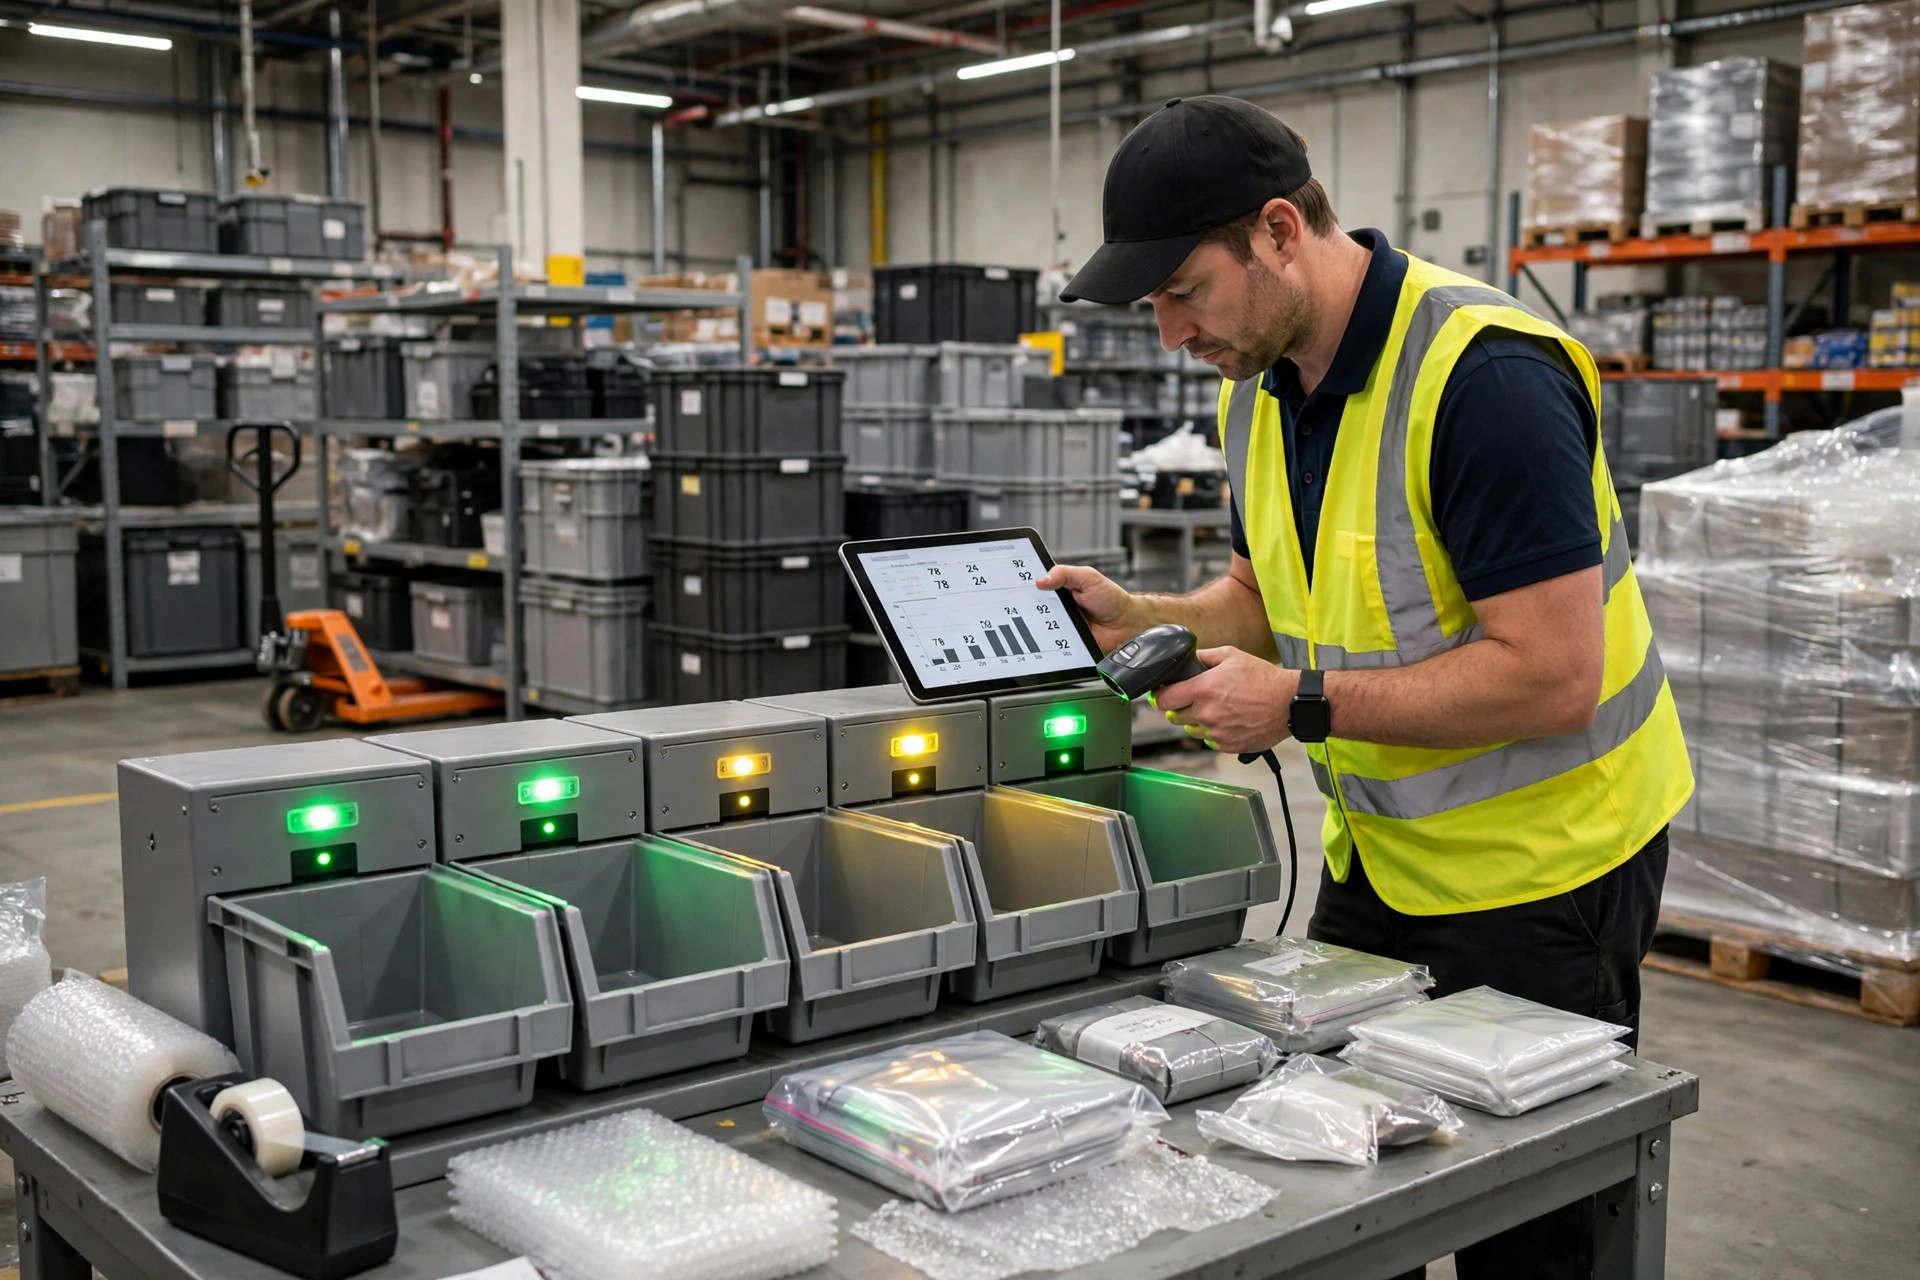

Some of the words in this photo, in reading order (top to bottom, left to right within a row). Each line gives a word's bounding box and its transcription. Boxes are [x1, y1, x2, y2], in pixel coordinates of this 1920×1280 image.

[927, 567, 941, 576] 78
[966, 564, 979, 573] 24
[1012, 559, 1026, 568] 92
[934, 580, 950, 590] 78
[972, 576, 987, 586] 24
[1018, 571, 1033, 581] 92
[1036, 604, 1050, 614] 92
[1055, 639, 1070, 649] 92
